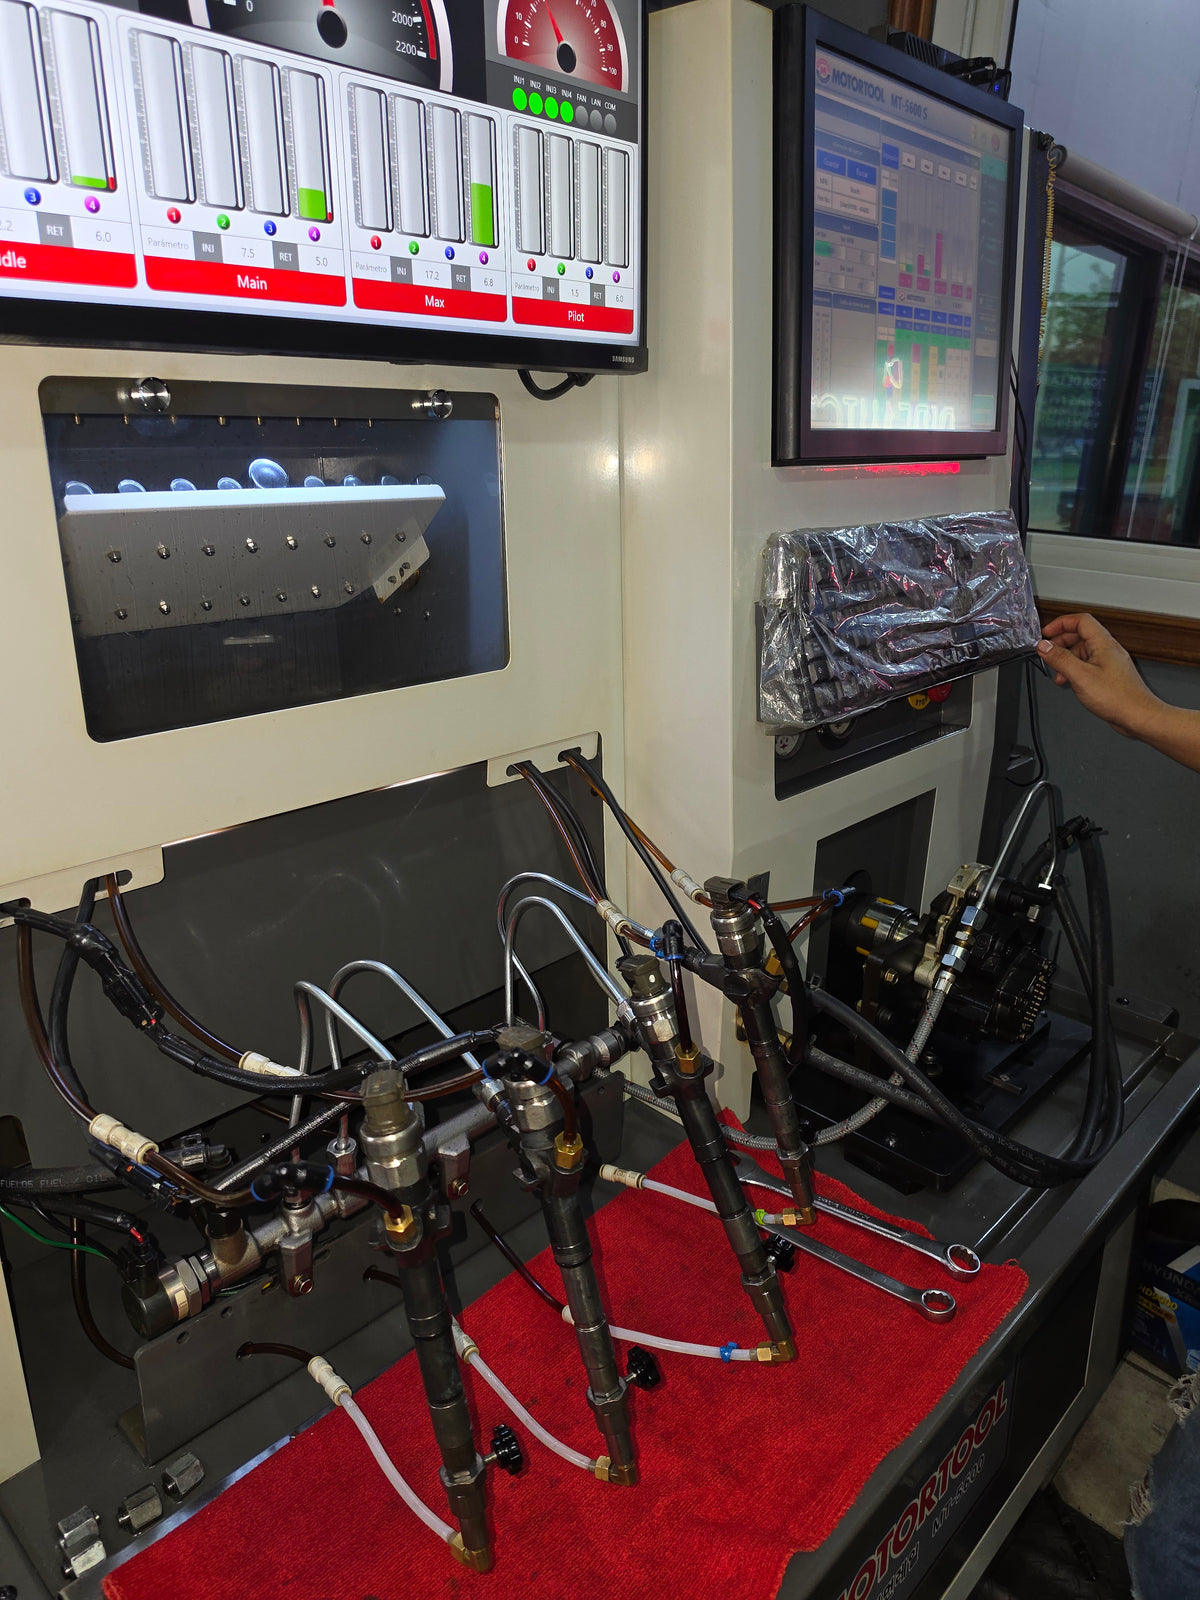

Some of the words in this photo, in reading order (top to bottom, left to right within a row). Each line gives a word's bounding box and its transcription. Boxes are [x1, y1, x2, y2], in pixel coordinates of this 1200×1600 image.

[246, 0, 254, 12] 0
[391, 11, 413, 27] 2000
[515, 12, 522, 20] 10
[600, 20, 607, 28] 80
[395, 40, 417, 56] 2200
[607, 43, 613, 52] 90
[609, 67, 617, 75] 100
[513, 75, 525, 85] INJ1
[529, 80, 541, 90] INJ2
[545, 84, 557, 94] INJ3
[561, 89, 572, 98] INJ4
[576, 93, 587, 103] FAN
[591, 98, 601, 107] LAN
[604, 101, 617, 111] COM
[832, 68, 885, 103] MOTORTOOL
[29, 192, 37, 202] 3
[89, 200, 97, 210] 4
[46, 224, 64, 237] RET
[95, 231, 112, 243] 6.0
[202, 243, 215, 253] INJ
[241, 247, 255, 259] 7.5
[279, 252, 293, 262] RET
[315, 256, 328, 267] 5.0
[237, 274, 268, 291] Main
[396, 266, 407, 276] INJ
[425, 270, 440, 280] 17.2
[456, 274, 466, 283] RET
[484, 278, 494, 287] 6.8
[424, 294, 445, 308] Max
[571, 289, 579, 297] 1.5
[593, 292, 602, 300] RET
[616, 295, 624, 303] 6.0
[567, 310, 585, 323] Pilot
[612, 355, 635, 363] SAMSUNG
[86, 1174, 107, 1184] OIL
[836, 1380, 1008, 1600] OTORTOOL
